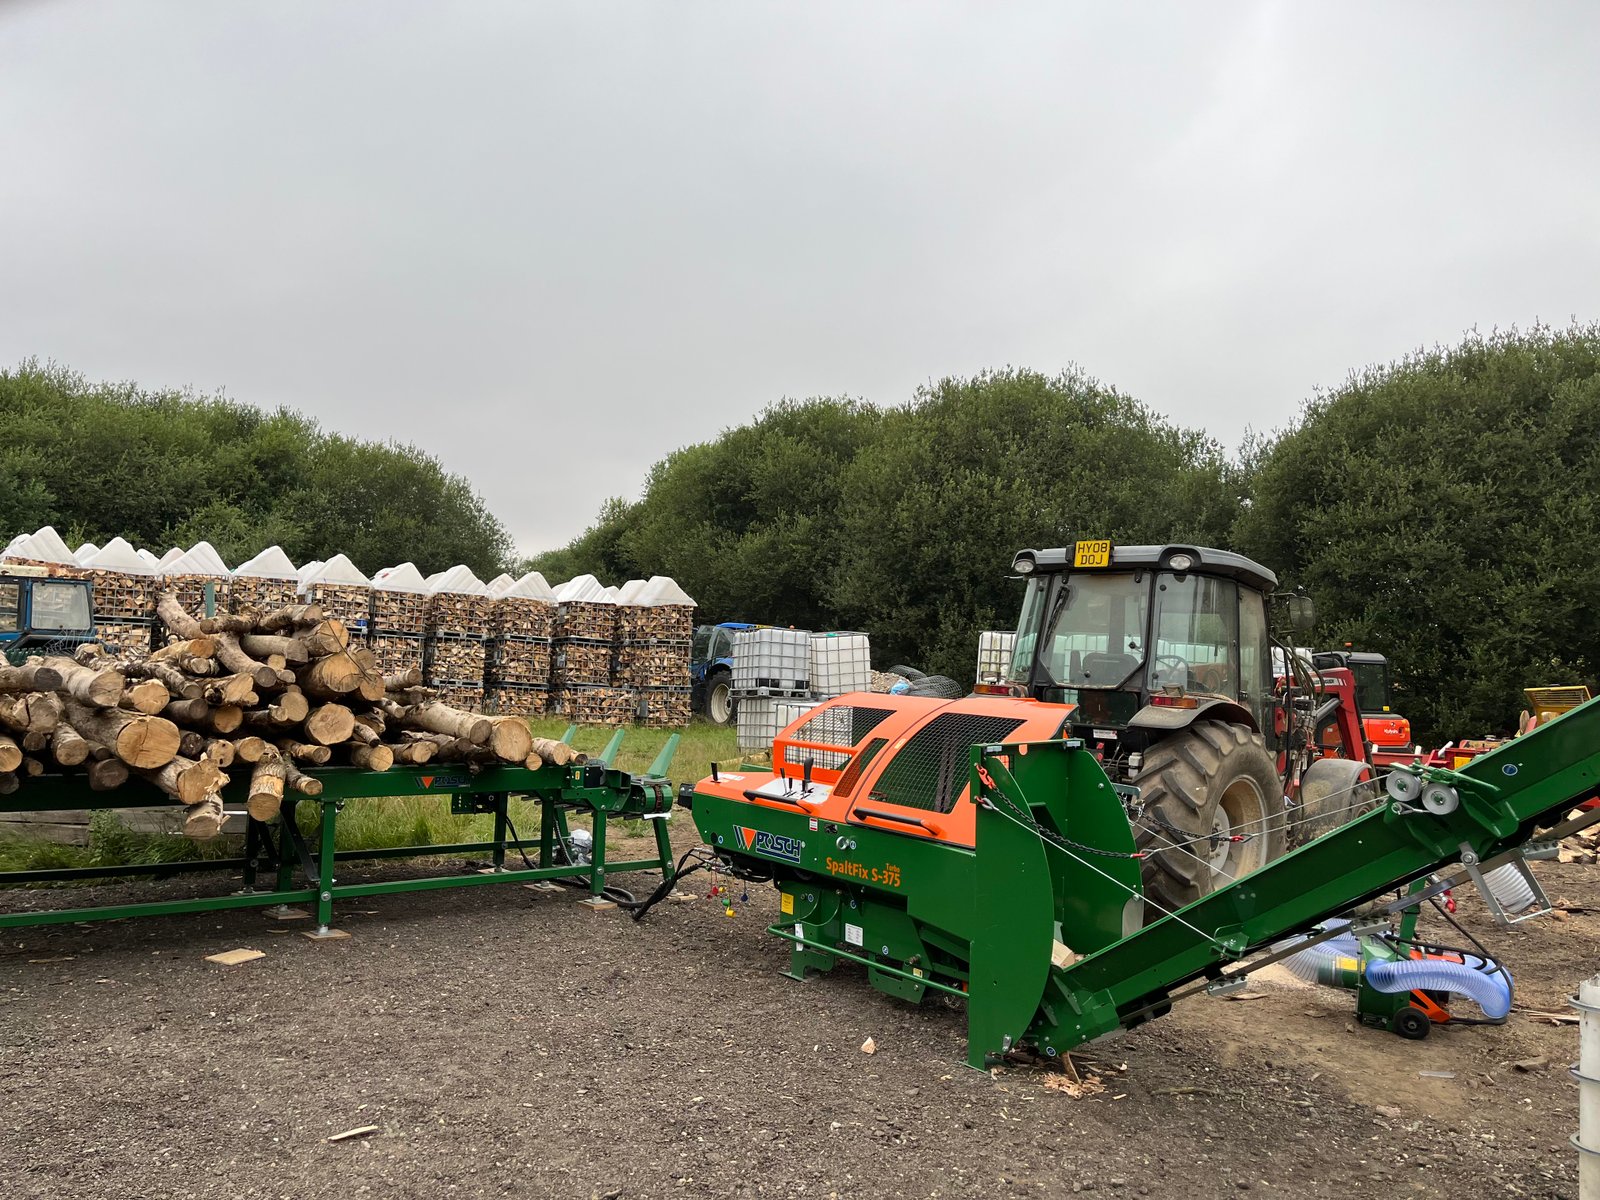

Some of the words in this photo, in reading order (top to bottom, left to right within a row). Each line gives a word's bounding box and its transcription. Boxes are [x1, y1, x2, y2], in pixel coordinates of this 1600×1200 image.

[1080, 554, 1103, 565] DOJ
[756, 830, 801, 858] POSCH
[826, 857, 869, 878] SpaltFix
[871, 867, 901, 887] S-375
